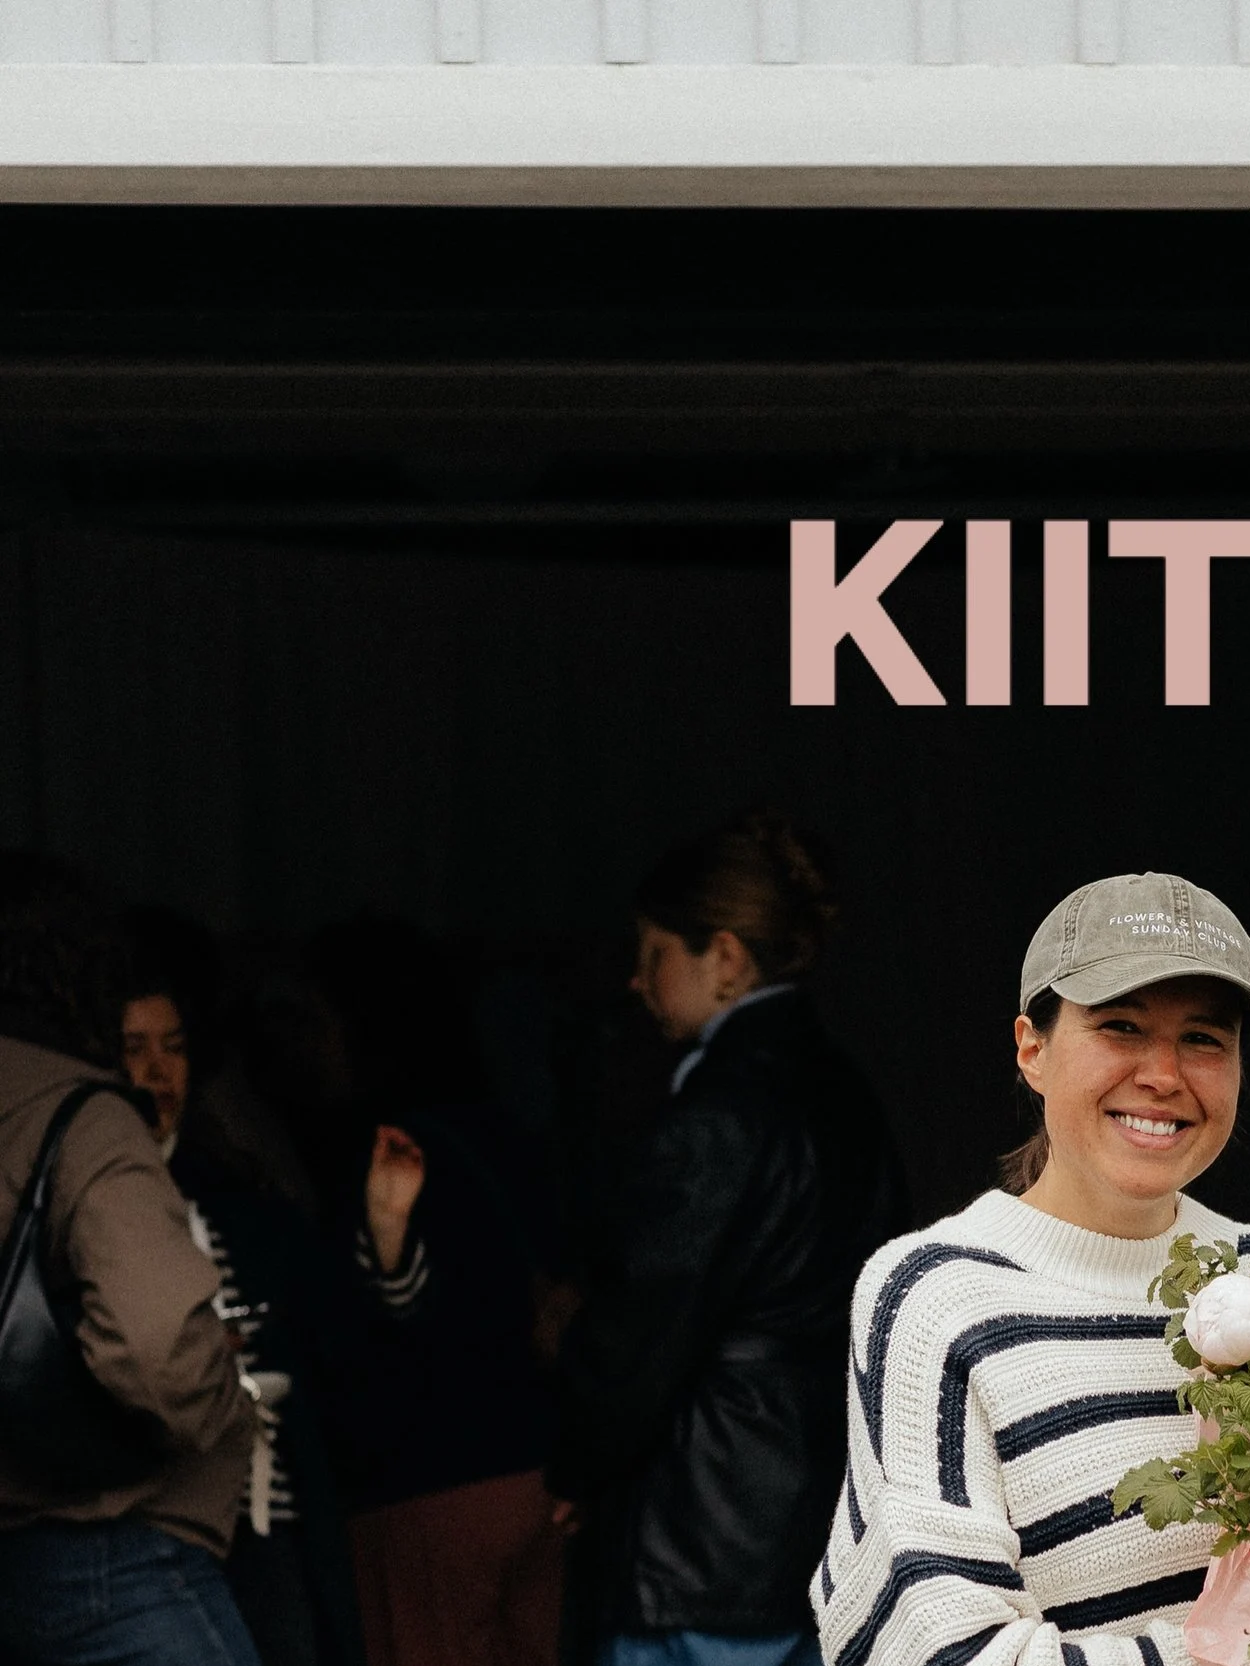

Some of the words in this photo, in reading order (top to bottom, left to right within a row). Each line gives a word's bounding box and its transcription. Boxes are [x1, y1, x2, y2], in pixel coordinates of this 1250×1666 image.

[1109, 912, 1172, 926] FLOWERS
[1179, 918, 1189, 928] &
[1195, 919, 1241, 949] VINTAGE
[1132, 924, 1189, 937] SUNDAY
[1197, 932, 1226, 951] CLUB
